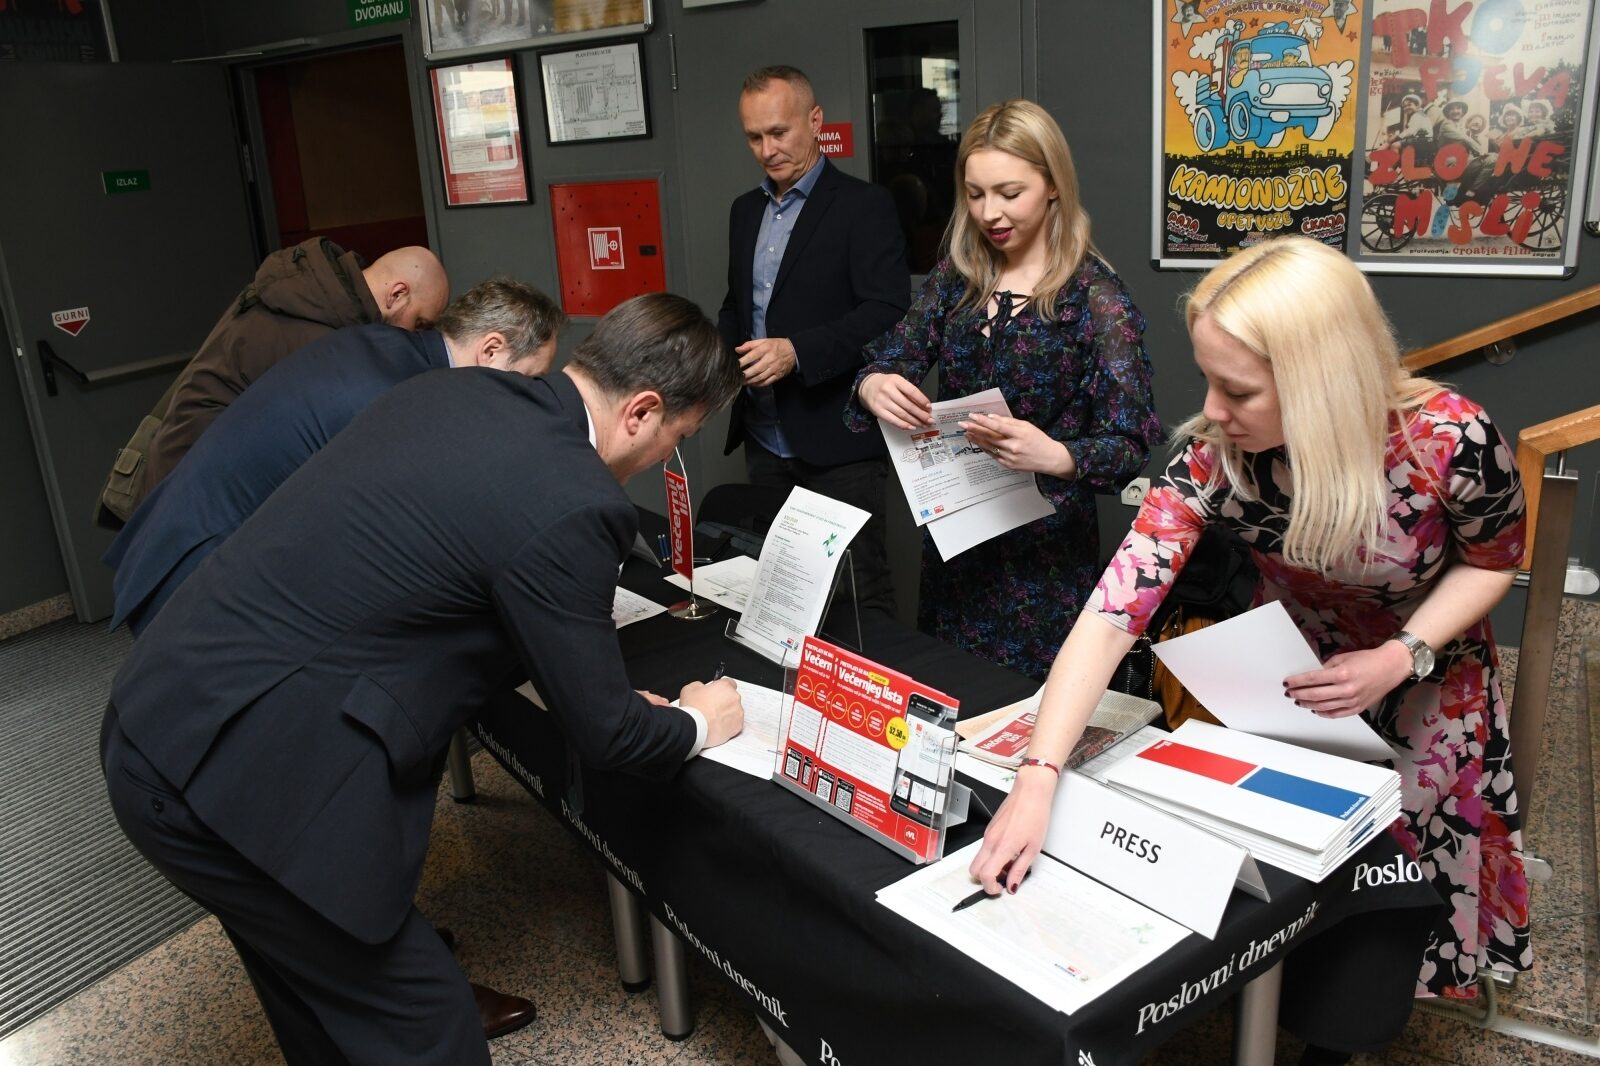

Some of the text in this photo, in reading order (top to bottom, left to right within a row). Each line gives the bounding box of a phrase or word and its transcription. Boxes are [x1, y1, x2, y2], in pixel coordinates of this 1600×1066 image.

[355, 2, 403, 21] DVORANU
[1373, 0, 1525, 67] TKO
[1419, 56, 1570, 108] PJEVA
[817, 132, 841, 142] NIMA
[820, 144, 843, 153] NJEN!
[116, 177, 138, 186] IZLAZ
[1368, 136, 1566, 185] ZLO NE
[1169, 164, 1347, 211] KAMIONDŽIJE
[1394, 183, 1541, 245] MISLI
[54, 310, 88, 322] GURNI
[667, 476, 683, 565] Večernji
[805, 649, 832, 671] Večern
[839, 667, 882, 699] Večernjeg
[882, 686, 903, 705] lista
[1100, 821, 1162, 864] PRESS
[603, 841, 647, 896] dnevnik
[1352, 854, 1423, 892] Poslo
[663, 901, 790, 1029] Poslovni dnevnik
[1135, 901, 1320, 1036] Poslovni dnevnik
